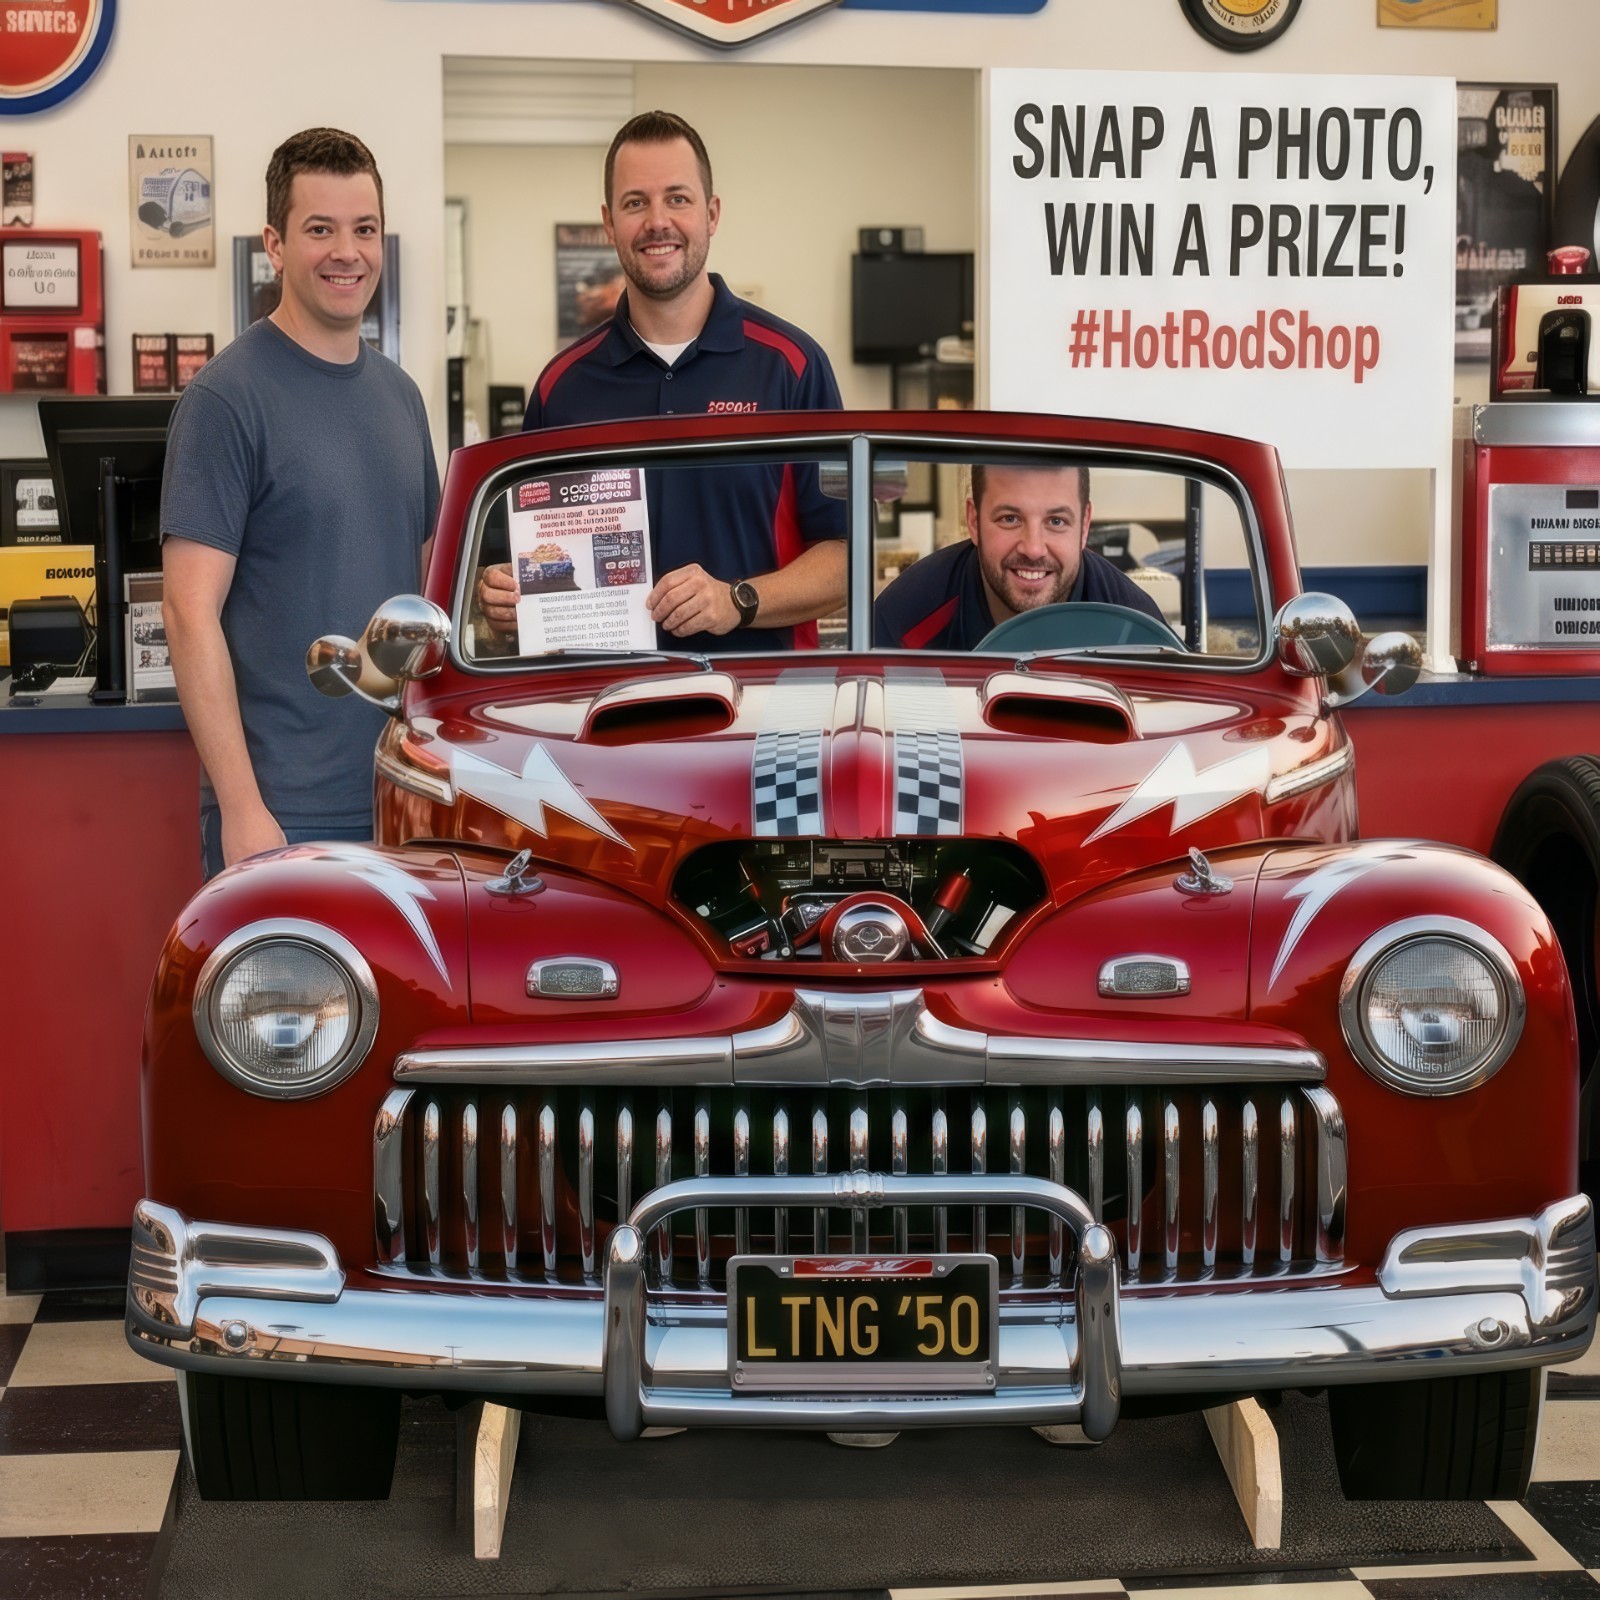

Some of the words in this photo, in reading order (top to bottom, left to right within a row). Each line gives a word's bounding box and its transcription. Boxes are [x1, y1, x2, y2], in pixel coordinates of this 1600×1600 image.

[1012, 102, 1165, 180] SNAP
[1180, 106, 1217, 179] A
[1237, 106, 1434, 195] PHOTO,
[1044, 202, 1155, 277] WIN
[1172, 203, 1210, 277] A
[1229, 203, 1406, 278] PRIZE!
[1069, 309, 1379, 384] #HotRodShop
[746, 1296, 879, 1357] LTNG
